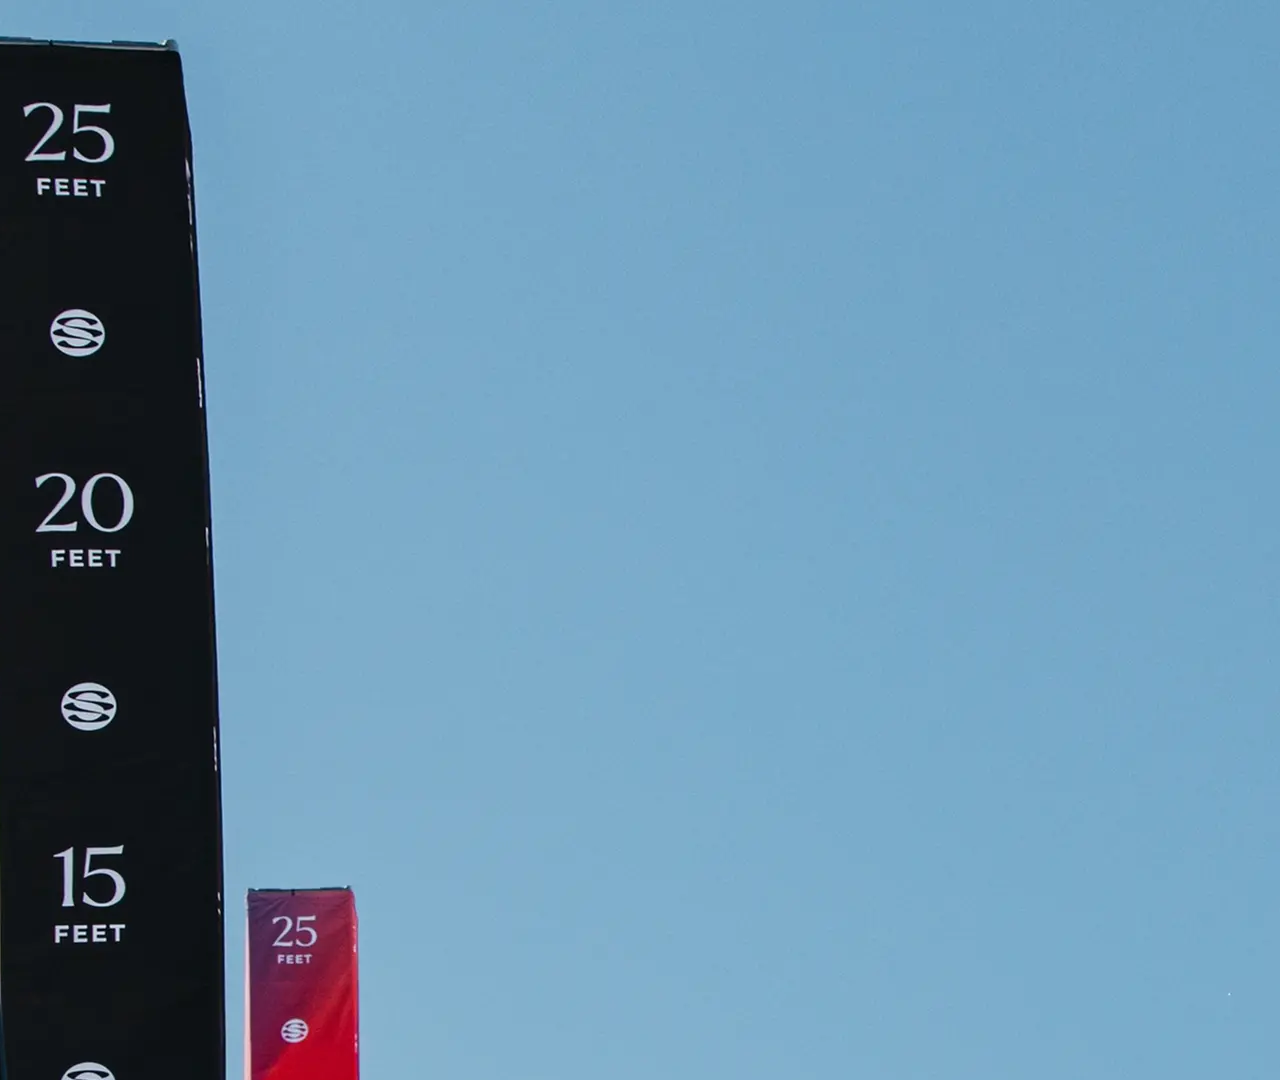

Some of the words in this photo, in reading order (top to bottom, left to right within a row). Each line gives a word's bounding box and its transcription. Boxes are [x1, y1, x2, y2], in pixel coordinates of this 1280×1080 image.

[22, 101, 115, 163] 25
[36, 177, 106, 198] FEET
[34, 472, 135, 534] 20
[51, 548, 121, 568] FEET
[52, 844, 127, 909] 15
[54, 923, 126, 944] FEET
[271, 914, 318, 948] 25
[277, 953, 313, 965] FEET
